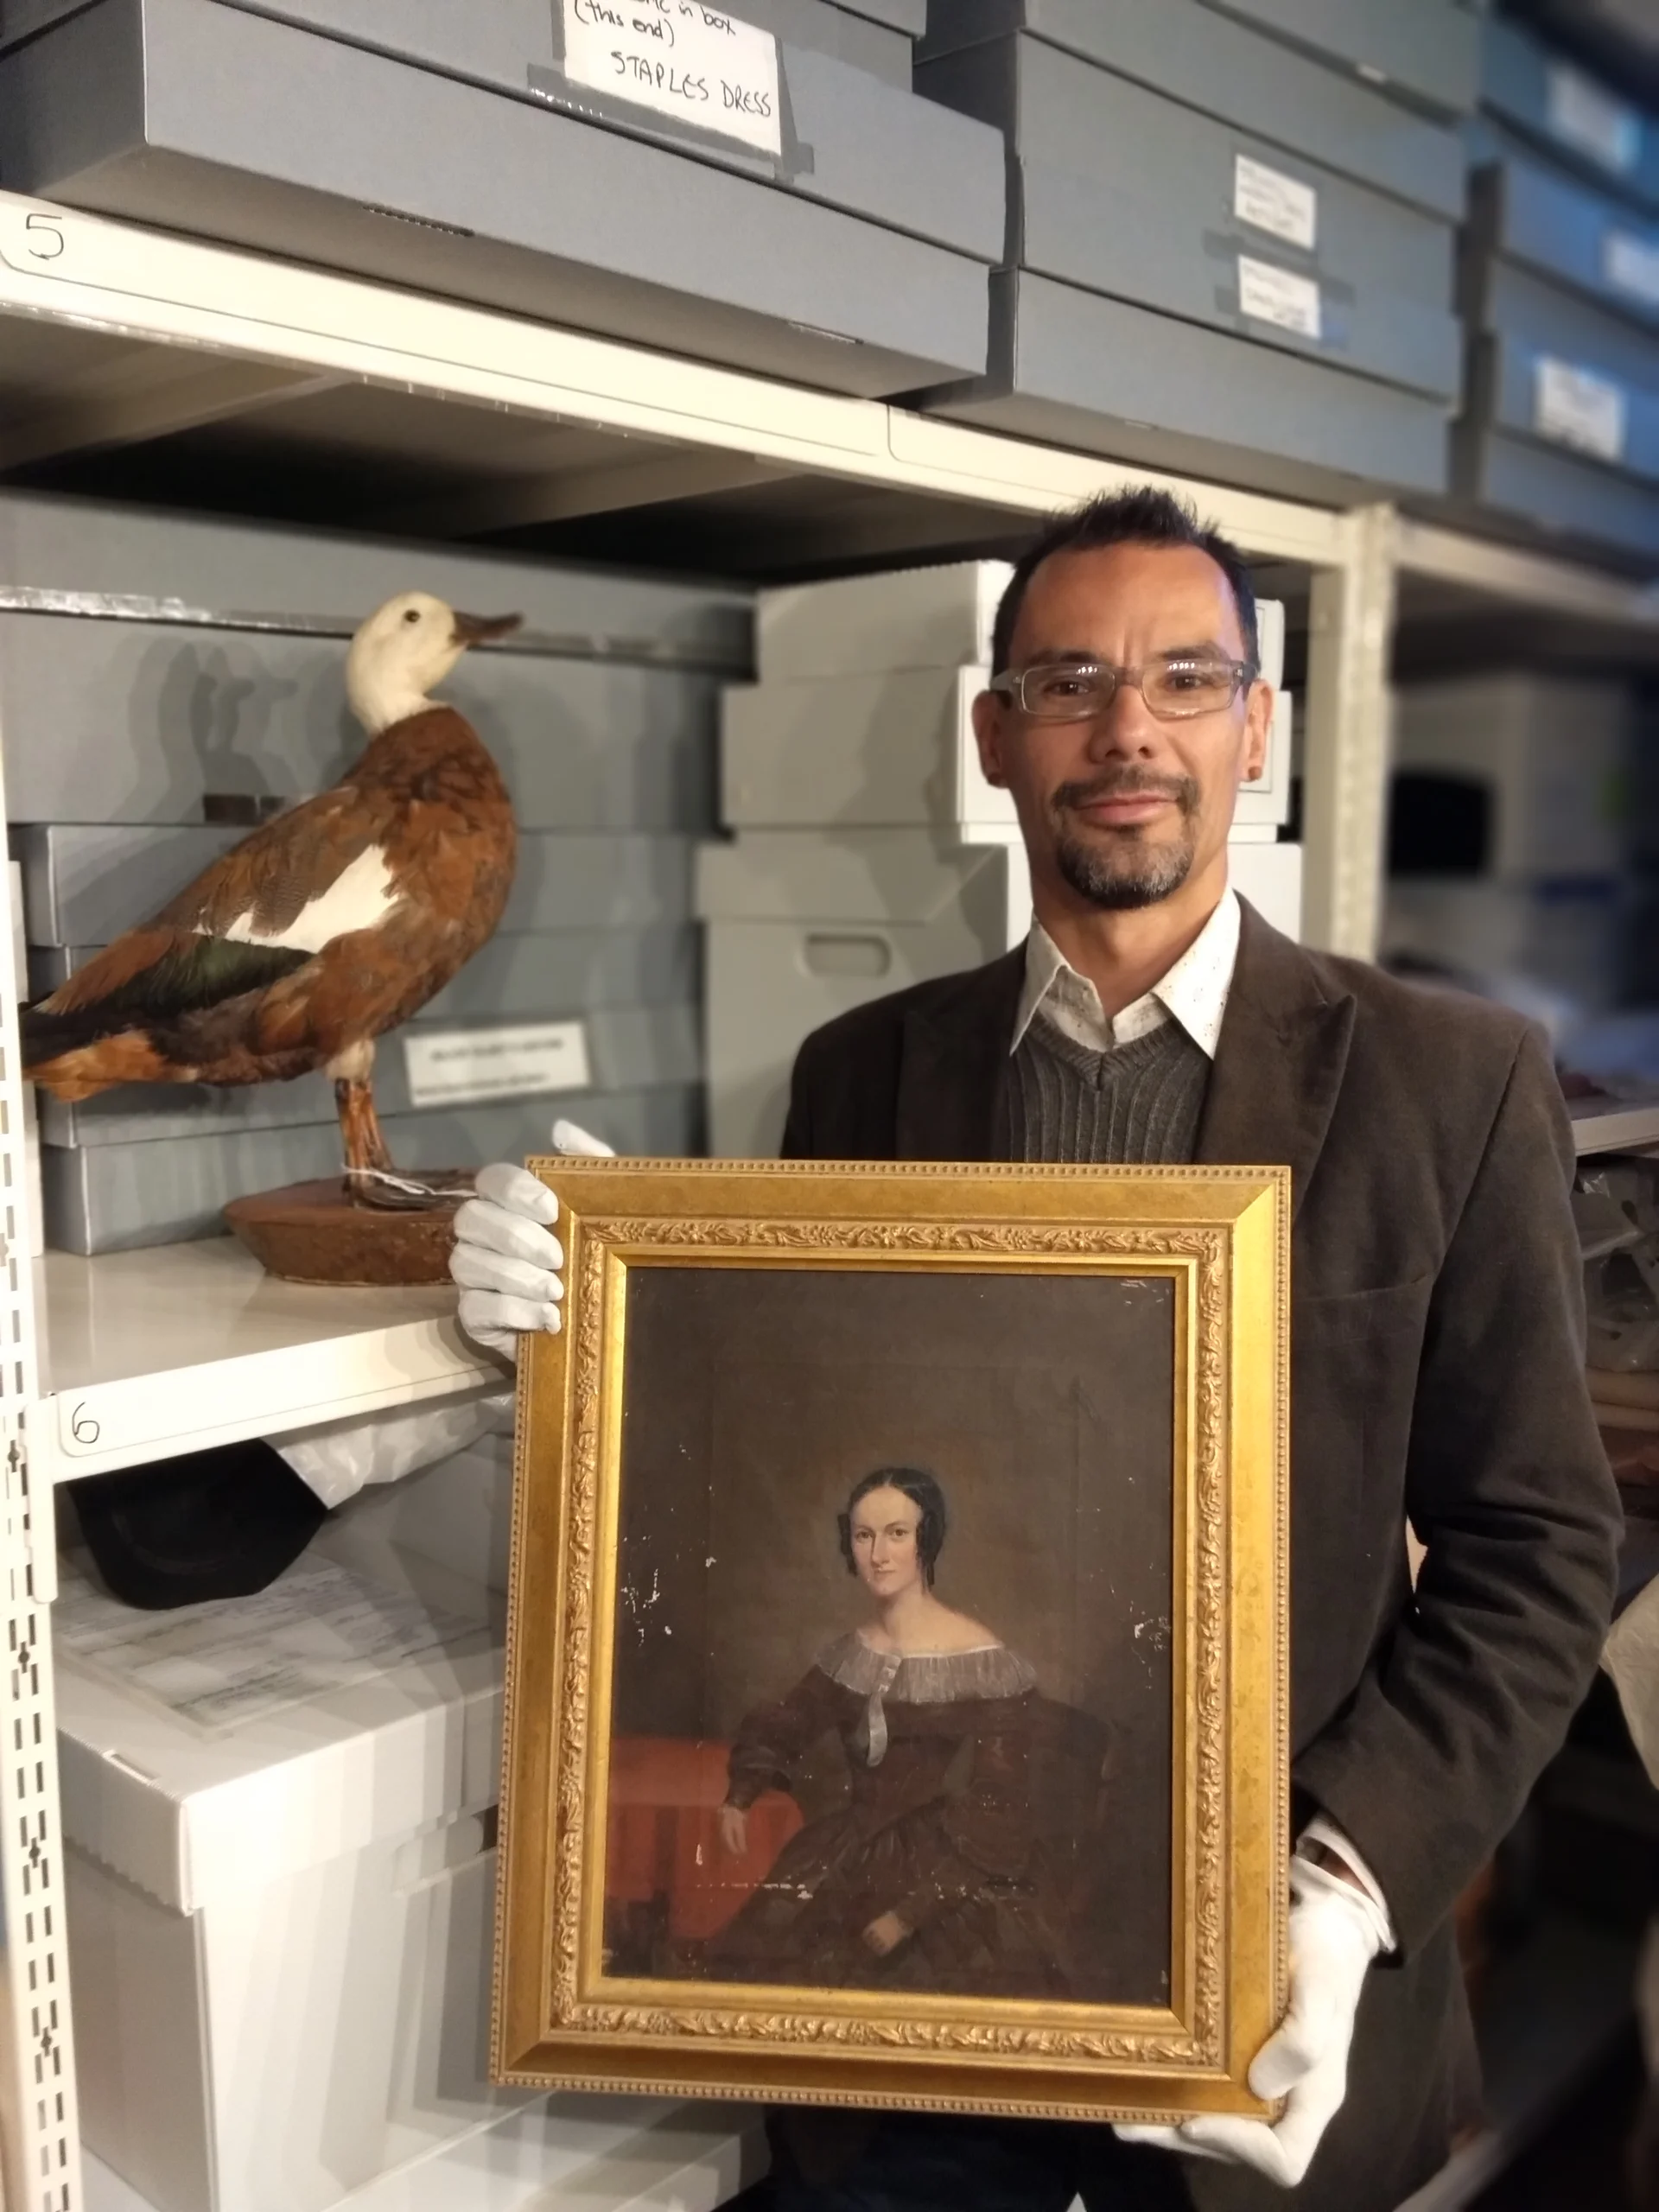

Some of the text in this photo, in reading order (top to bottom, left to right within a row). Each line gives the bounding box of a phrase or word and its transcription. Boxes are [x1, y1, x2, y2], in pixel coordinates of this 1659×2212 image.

[632, 19, 675, 48] end)
[679, 2, 693, 17] in
[701, 6, 736, 35] box
[611, 51, 772, 118] STAPLES DRESS
[26, 213, 64, 260] 5
[72, 1401, 100, 1444] 6
